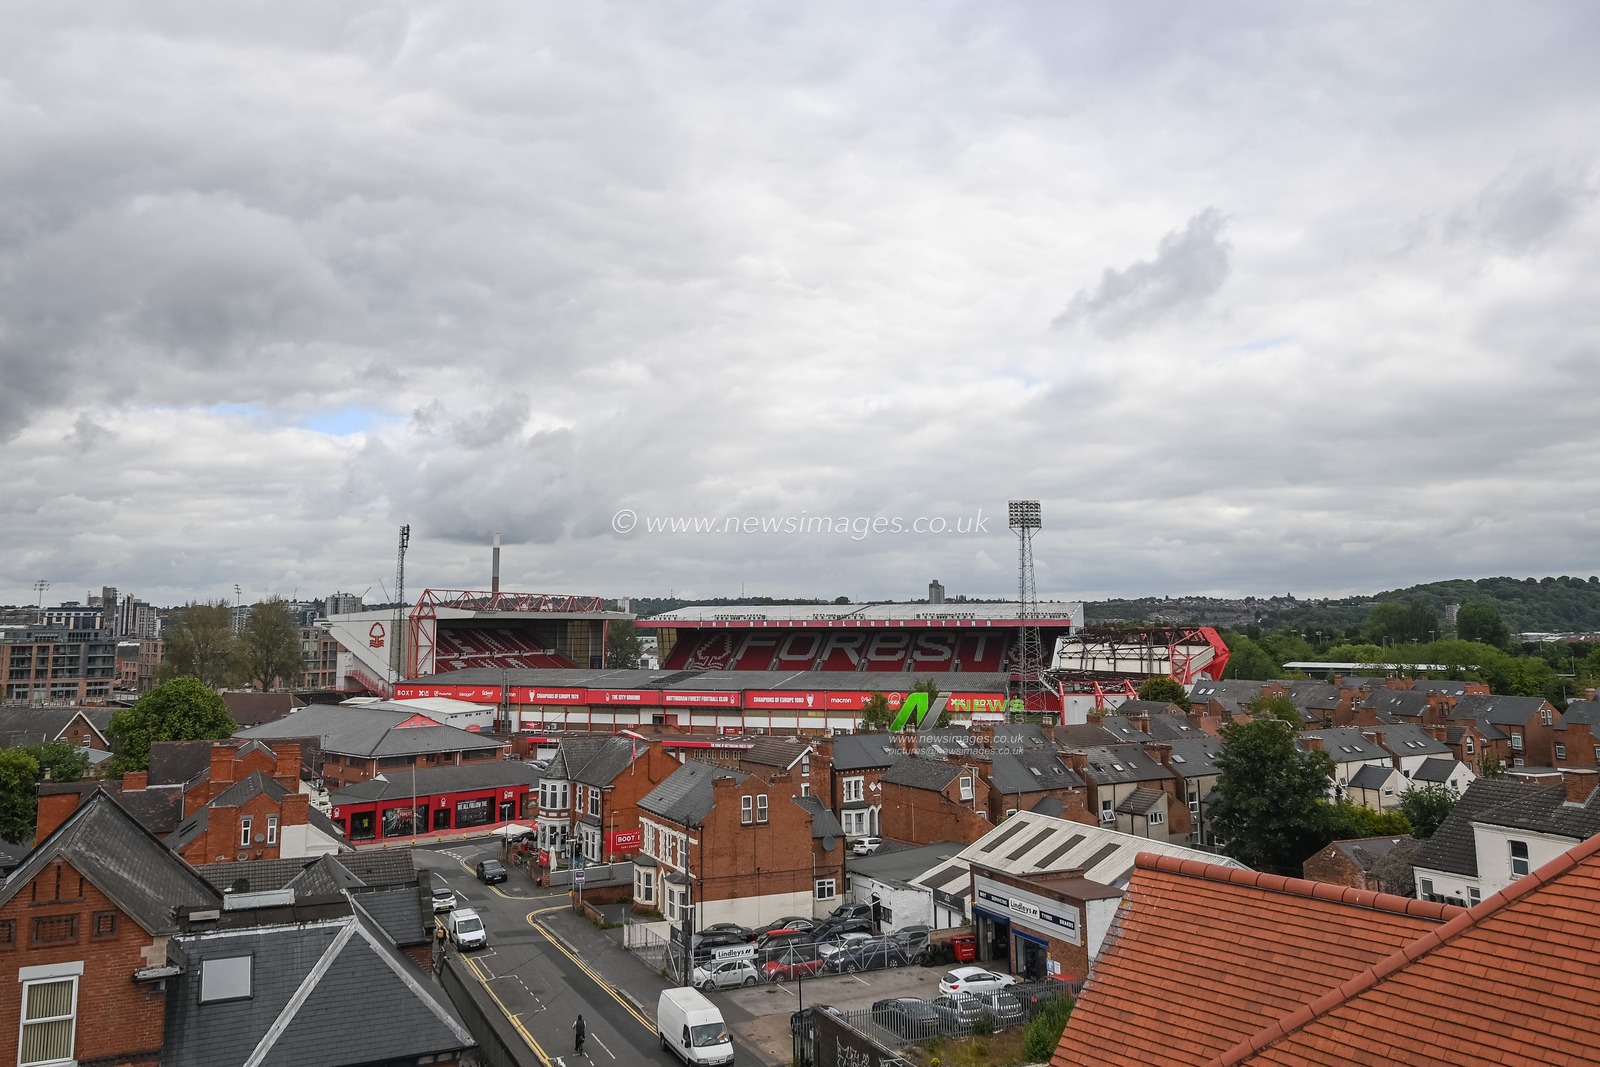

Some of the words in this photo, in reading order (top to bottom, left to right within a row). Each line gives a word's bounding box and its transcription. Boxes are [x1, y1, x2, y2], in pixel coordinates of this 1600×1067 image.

[617, 835, 635, 843] BOOT
[1010, 900, 1032, 914] Lindleys
[1059, 919, 1074, 929] BRAKES
[718, 949, 744, 958] Lindleys
